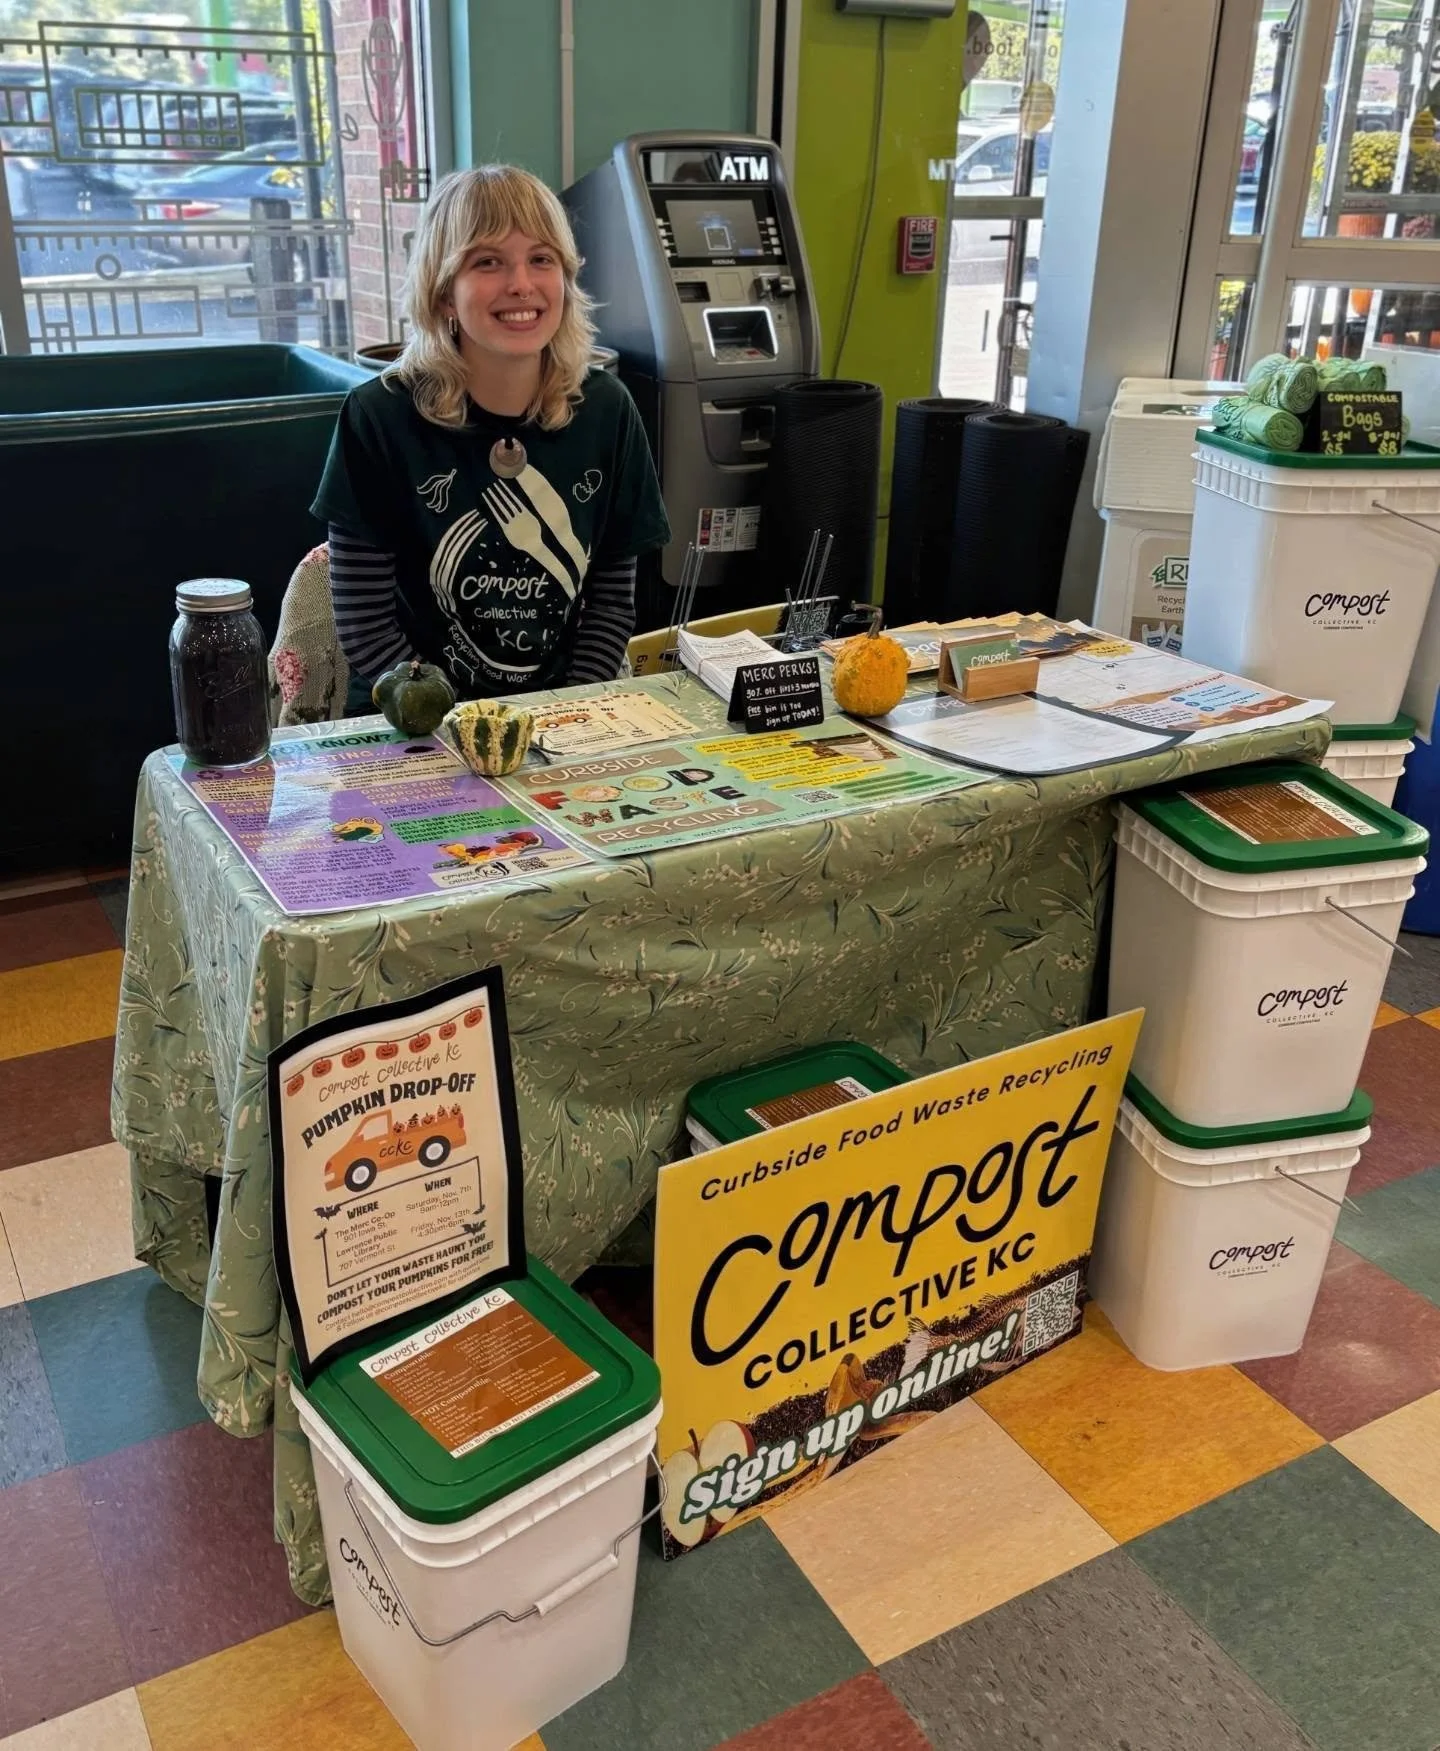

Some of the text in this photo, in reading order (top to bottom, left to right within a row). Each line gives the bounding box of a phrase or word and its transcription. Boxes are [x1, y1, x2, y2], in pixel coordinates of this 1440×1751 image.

[720, 157, 768, 180] ATM
[909, 219, 935, 232] FIRE
[1343, 405, 1383, 431] Bags
[460, 572, 549, 600] Compost
[474, 604, 538, 619] Collective
[1305, 590, 1390, 617] Compost
[496, 628, 532, 650] KC
[742, 662, 817, 683] MERC PERKS!
[765, 705, 777, 713] bin
[792, 706, 820, 720] TODAY!
[316, 733, 391, 749] KNOW?
[411, 778, 457, 787] FAMILY
[528, 754, 661, 786] CURBSIDE
[367, 785, 449, 799] COMPOSTING
[528, 768, 715, 810] FOOD
[563, 786, 748, 828] WASTE
[597, 802, 759, 844] RECYCLING
[1258, 980, 1348, 1016] Compost
[319, 1073, 369, 1102] Compost
[377, 1053, 440, 1084] Collective
[301, 1073, 477, 1149] PUMPKIN DROP-OFF
[701, 1143, 828, 1201] Curbside
[838, 1113, 902, 1152] Food
[911, 1087, 990, 1126] Waste
[998, 1044, 1113, 1095] Recycling
[406, 1196, 441, 1212] Saturday,
[460, 1185, 472, 1195] 7th
[425, 1178, 451, 1192] WHEN
[347, 1201, 379, 1220] WHERE
[453, 1209, 470, 1220] 13th
[335, 1211, 396, 1239] The Merc Co-Op
[344, 1231, 357, 1242] 901
[358, 1226, 376, 1237] Iowa
[691, 1085, 1100, 1367] Compost
[336, 1229, 398, 1258] Lawrence Public
[354, 1243, 381, 1258] Library
[1209, 1236, 1295, 1270] Compost
[327, 1233, 486, 1304] DON'T LET YOUR WASTE HAUNT YOU
[339, 1244, 396, 1271] 707 Vermont St
[317, 1241, 494, 1324] COMPOST YOUR PUMPKINS FOR FREE!
[744, 1231, 1036, 1389] COLLECTIVE KC
[370, 1340, 419, 1373] Compost
[425, 1305, 480, 1344] Collective
[421, 1403, 443, 1417] NOT
[683, 1313, 1021, 1520] Sign up online!
[340, 1537, 401, 1626] Compost
